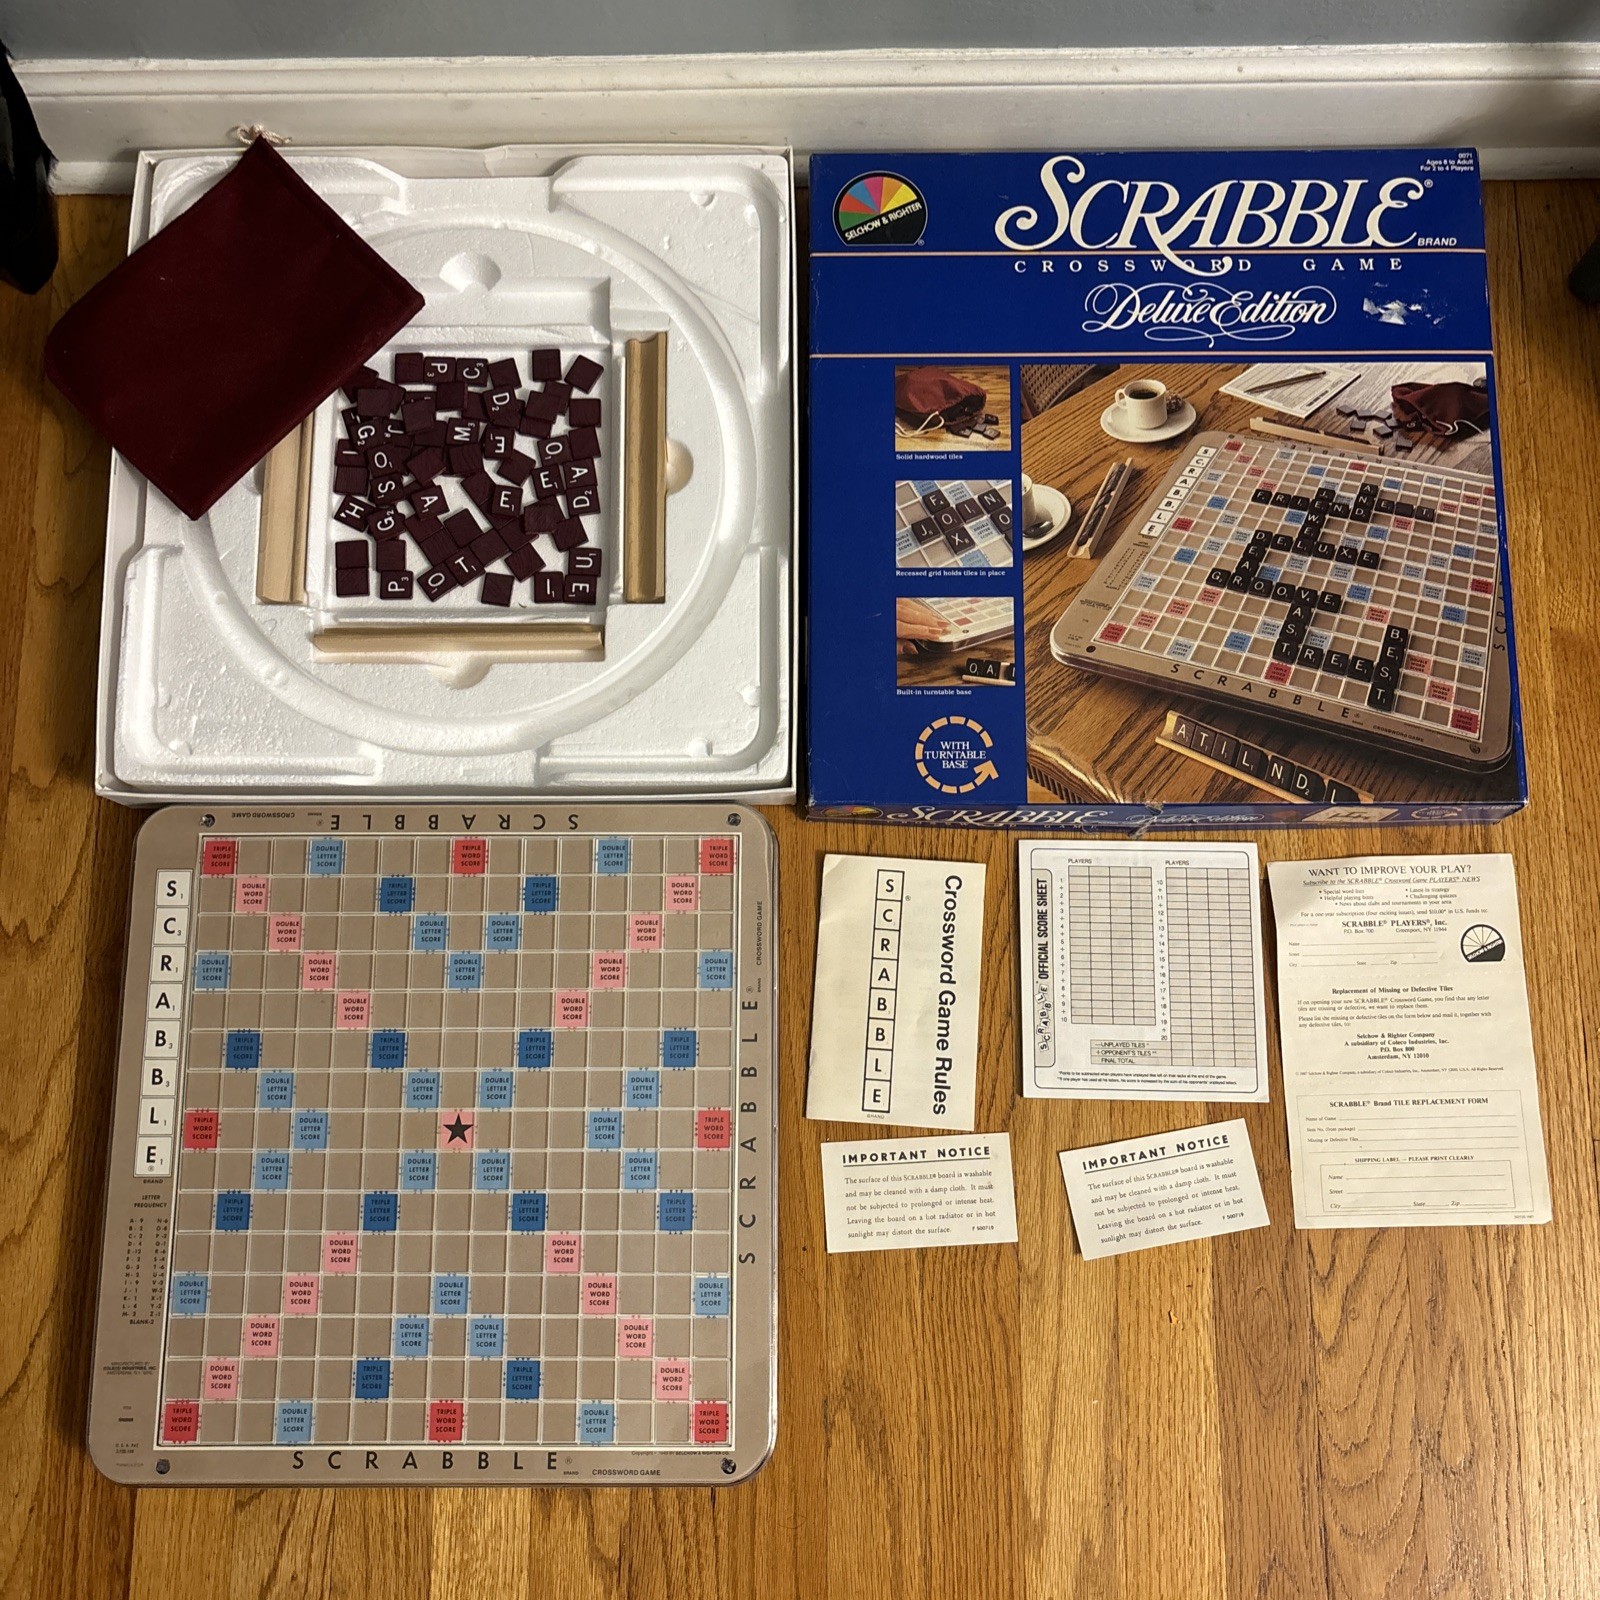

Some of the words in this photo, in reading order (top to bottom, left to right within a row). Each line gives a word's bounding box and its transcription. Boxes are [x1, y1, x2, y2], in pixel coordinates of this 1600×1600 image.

[845, 218, 882, 241] SELCHOW
[882, 216, 889, 225] &
[888, 202, 922, 220] RIGHTER
[1418, 237, 1456, 246] BRAND
[1302, 258, 1402, 272] GAME
[1082, 282, 1214, 333] Deluxe
[1209, 284, 1337, 336] Edition
[940, 741, 970, 750] WITH
[924, 751, 986, 759] TURNTABLE
[942, 760, 968, 769] BASE
[1308, 867, 1339, 876] WANT
[1342, 866, 1357, 874] TO
[1360, 865, 1406, 874] IMPROVE
[1409, 865, 1437, 873] YOUR
[1440, 864, 1471, 873] PLAY?
[1037, 878, 1048, 906] SHEET
[939, 875, 962, 984] Crossword
[1038, 909, 1048, 937] SCORE
[1038, 941, 1049, 979] OFFICIAL
[936, 990, 956, 1051] Game
[933, 1056, 953, 1115] Rules
[842, 1150, 926, 1163] IMPORTANT
[937, 1146, 989, 1157] NOTICE
[1082, 1146, 1165, 1170] IMPORTANT
[1176, 1134, 1228, 1152] NOTICE
[929, 1185, 948, 1194] damp
[869, 1201, 898, 1210] subjected
[910, 1198, 942, 1209] prolonged
[848, 1230, 873, 1239] sunlight
